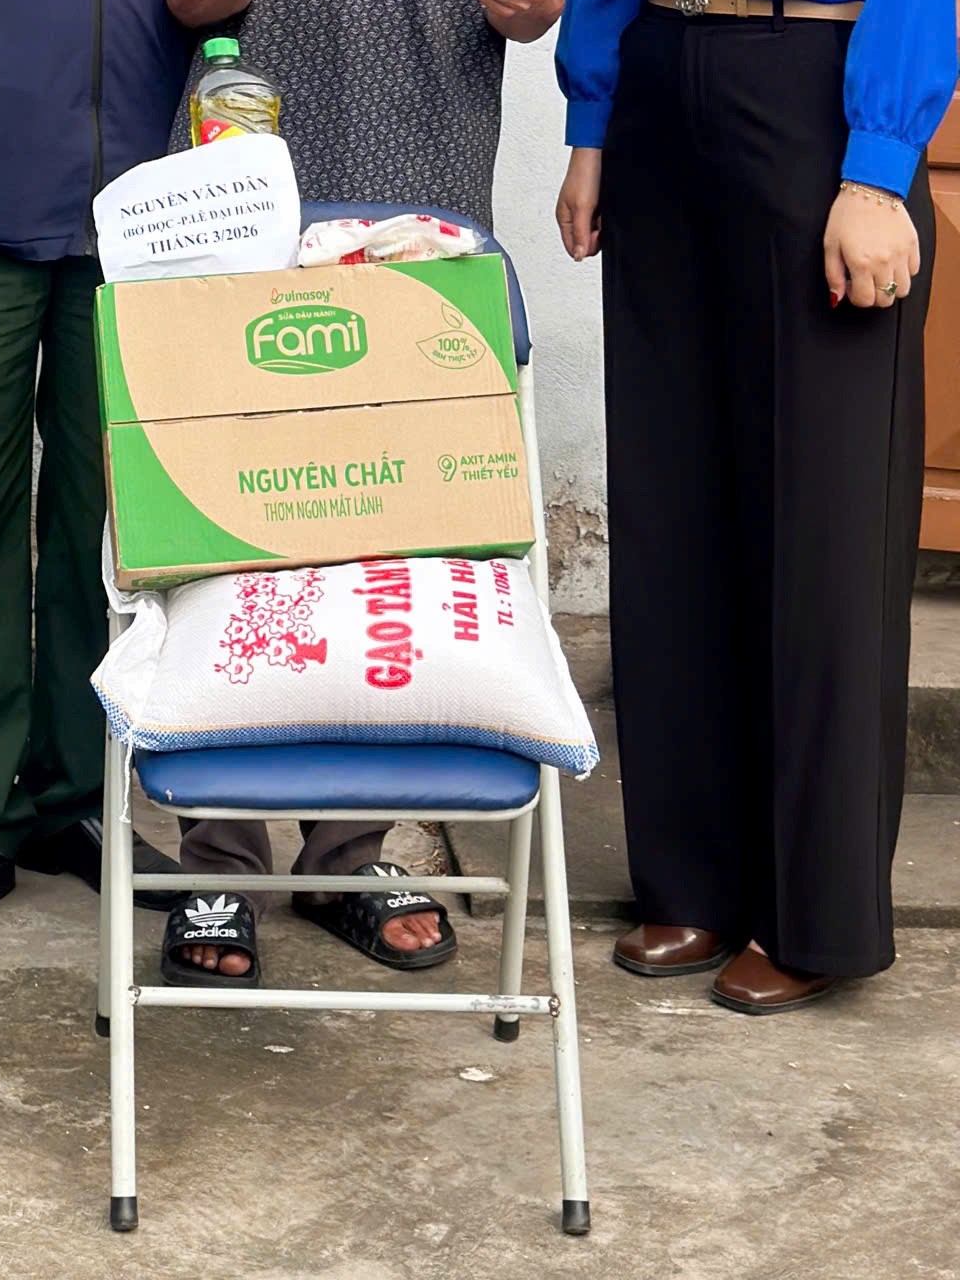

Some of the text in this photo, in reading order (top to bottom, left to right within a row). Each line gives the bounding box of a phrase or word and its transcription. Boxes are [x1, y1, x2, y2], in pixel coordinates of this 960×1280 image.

[233, 175, 270, 194] DÂN
[147, 224, 259, 255] THÁNG 3/2026
[438, 337, 470, 352] 100%
[238, 450, 406, 494] NGUYÊN CHẤT
[460, 454, 484, 466] AXIT
[487, 452, 517, 464] AMIN
[264, 492, 384, 522] THƠM NGON MÁT LÀNH
[352, 567, 413, 617] TÁM
[441, 590, 480, 642] HẢI
[365, 621, 423, 690] GẠO
